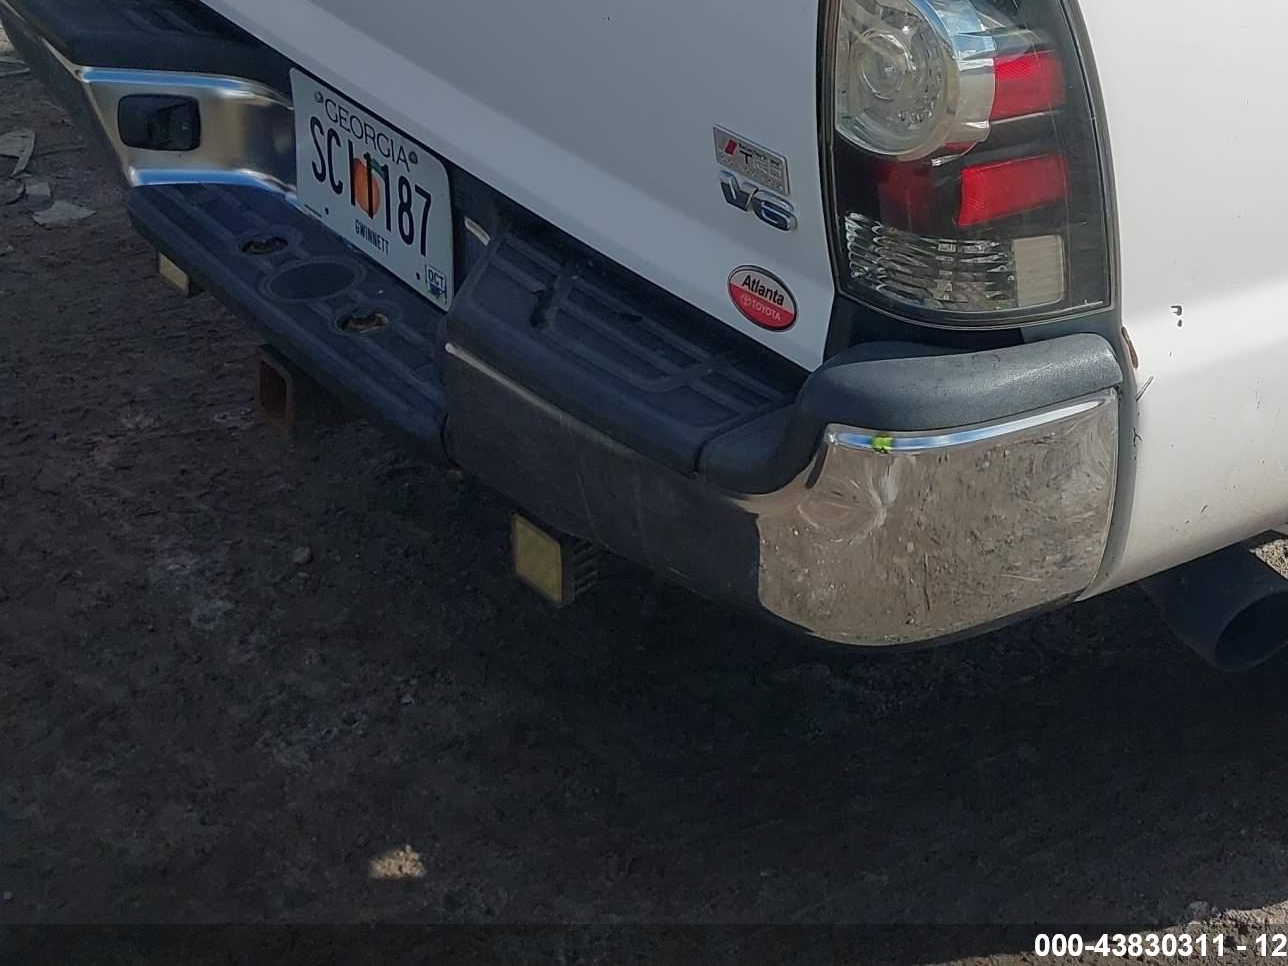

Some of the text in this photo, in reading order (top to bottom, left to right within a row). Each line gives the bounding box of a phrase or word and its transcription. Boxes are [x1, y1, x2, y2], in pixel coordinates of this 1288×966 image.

[325, 97, 411, 172] GEORGIA
[719, 169, 798, 232] V6
[354, 218, 390, 256] GWINNETT
[741, 274, 785, 307] Atlanta
[750, 298, 782, 322] TOYOTA
